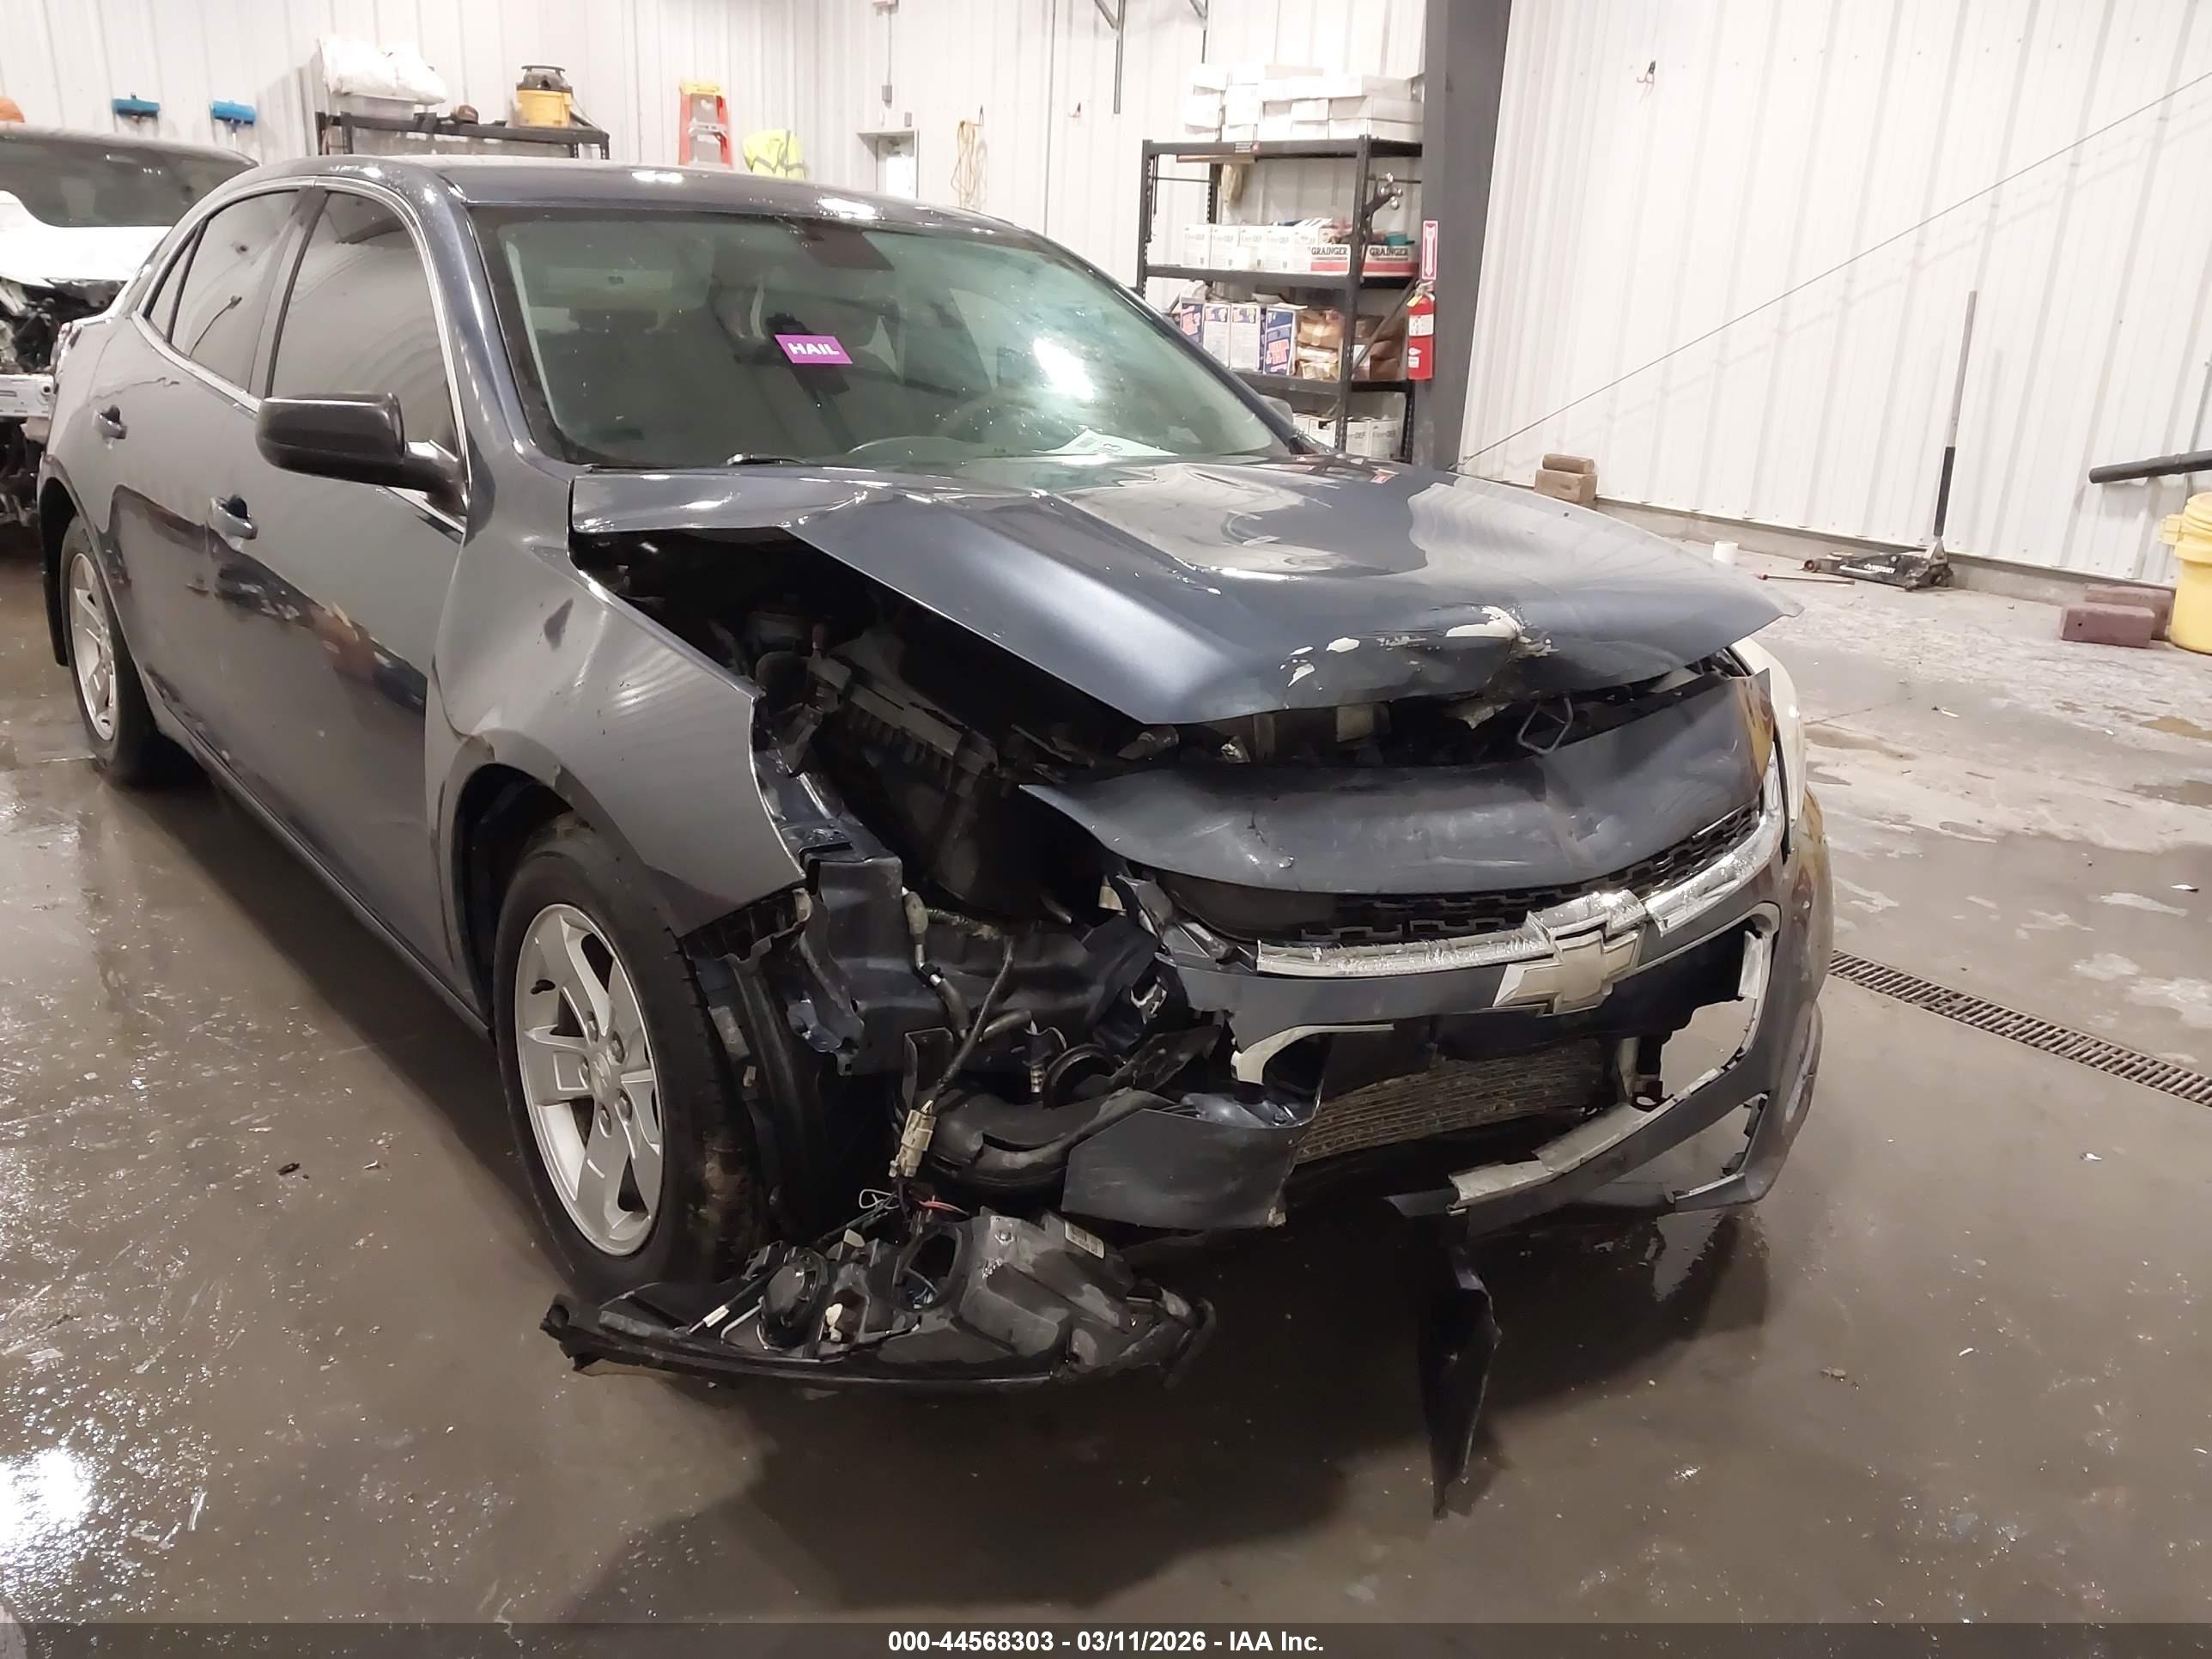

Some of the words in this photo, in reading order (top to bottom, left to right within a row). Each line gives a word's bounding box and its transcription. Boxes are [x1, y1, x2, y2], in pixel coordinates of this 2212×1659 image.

[1311, 246, 1348, 255] GRAINGER
[1370, 247, 1409, 256] GRAINGER
[787, 343, 840, 355] HAIL
